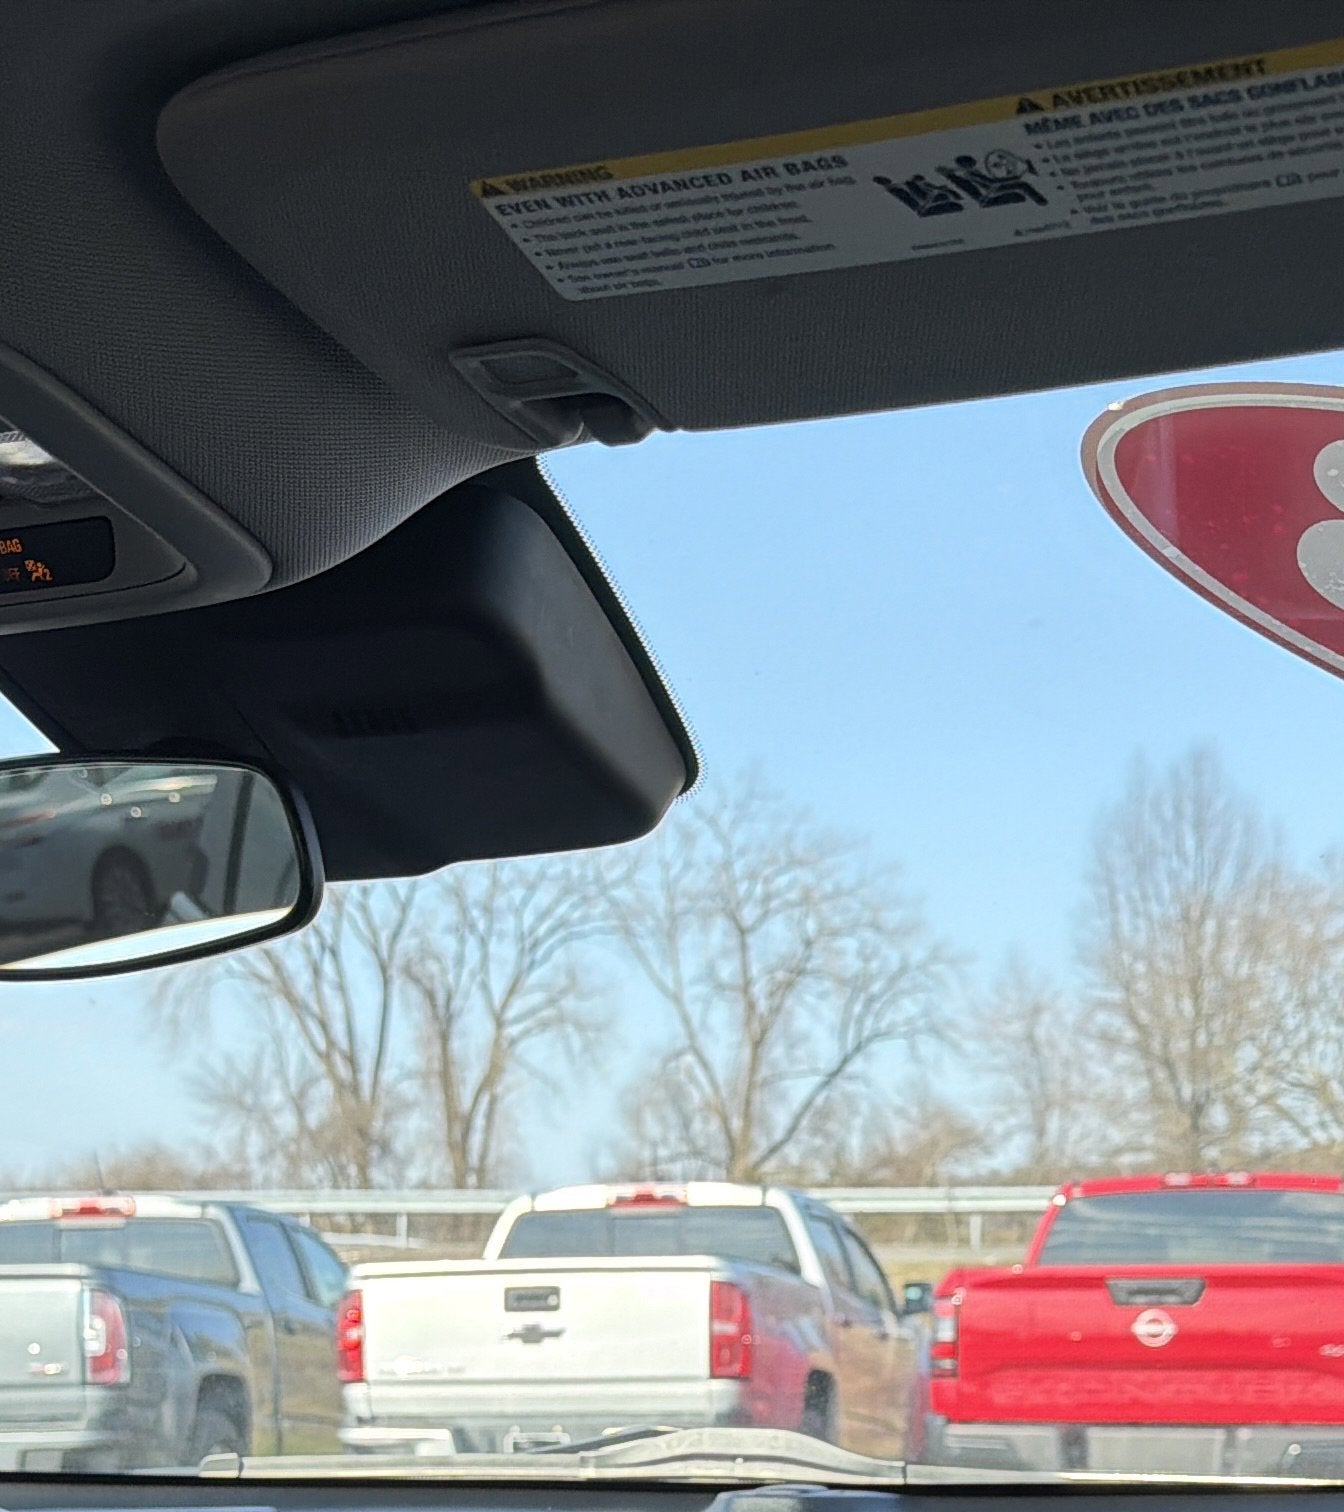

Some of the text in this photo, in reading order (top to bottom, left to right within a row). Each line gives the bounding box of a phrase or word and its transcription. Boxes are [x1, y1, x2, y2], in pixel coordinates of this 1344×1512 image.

[1052, 58, 1265, 109] AVERTISSEMENT
[1089, 106, 1140, 124] AVEC
[1143, 99, 1184, 116] DES
[1187, 89, 1242, 107] SACS
[495, 154, 849, 216] EVEN WITH ADVANCED AIR BAGS
[506, 165, 613, 191] WARNING
[807, 180, 825, 190] air
